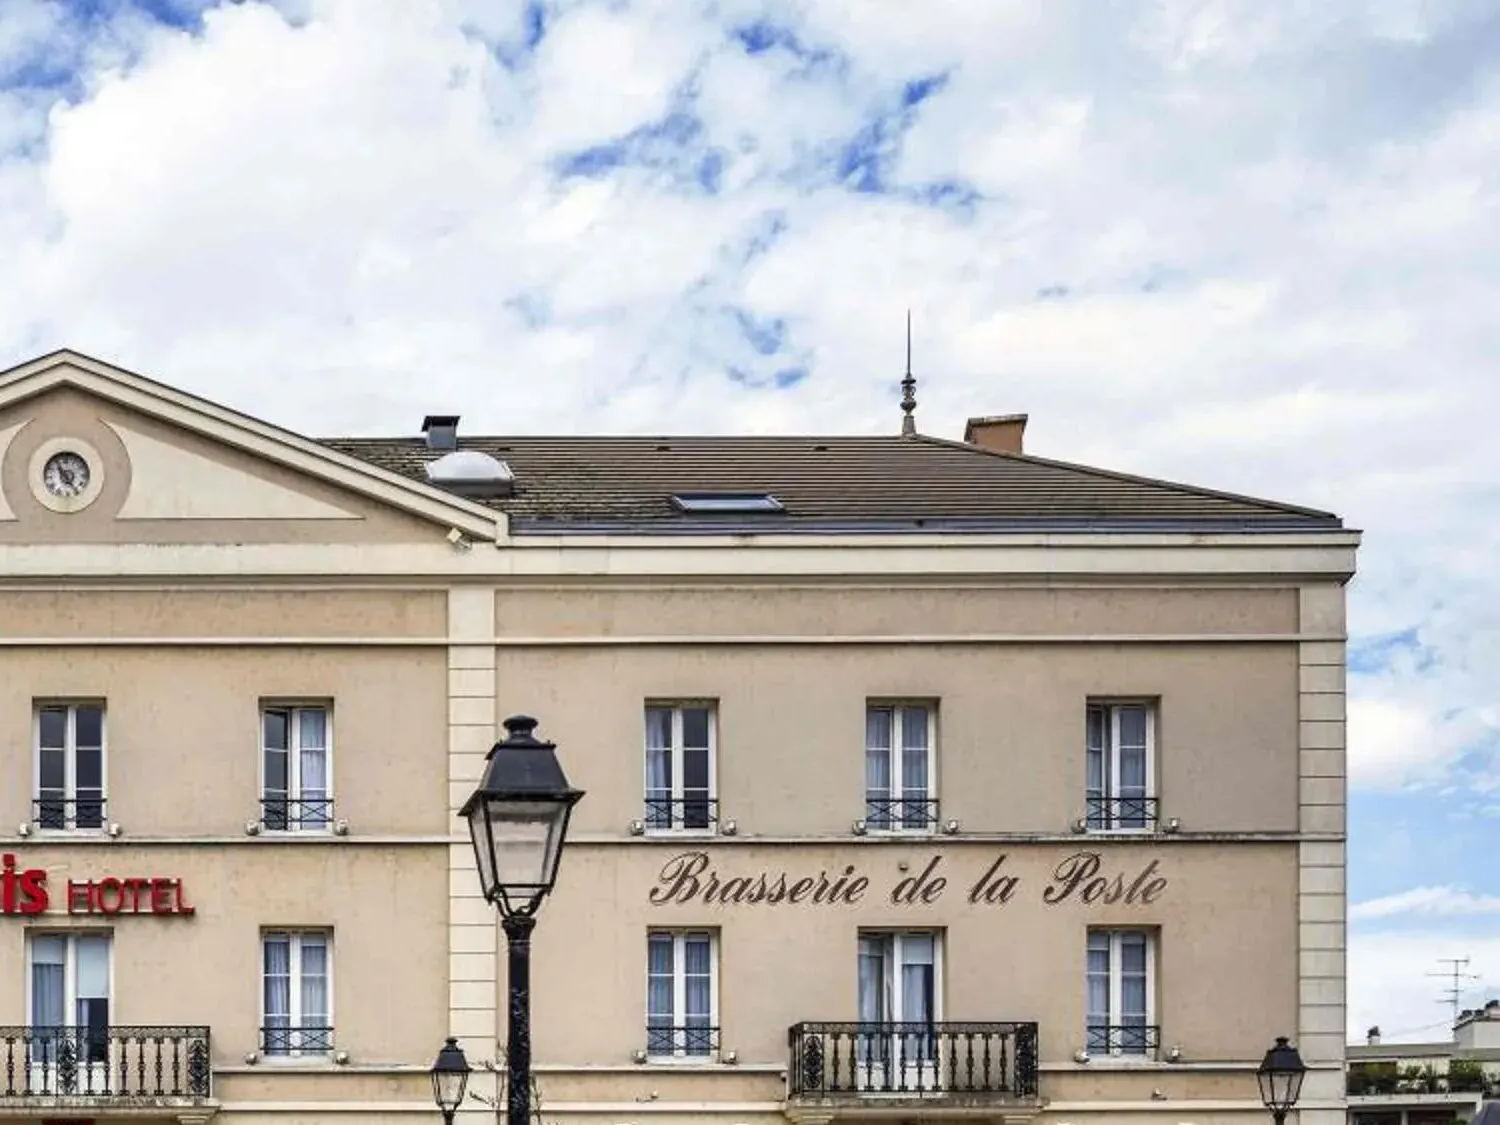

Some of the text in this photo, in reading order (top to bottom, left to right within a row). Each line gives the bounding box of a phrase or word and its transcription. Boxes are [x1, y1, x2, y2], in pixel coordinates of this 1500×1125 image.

[68, 877, 196, 915] HOTEL
[649, 851, 1168, 906] Brasserie de la Poste
